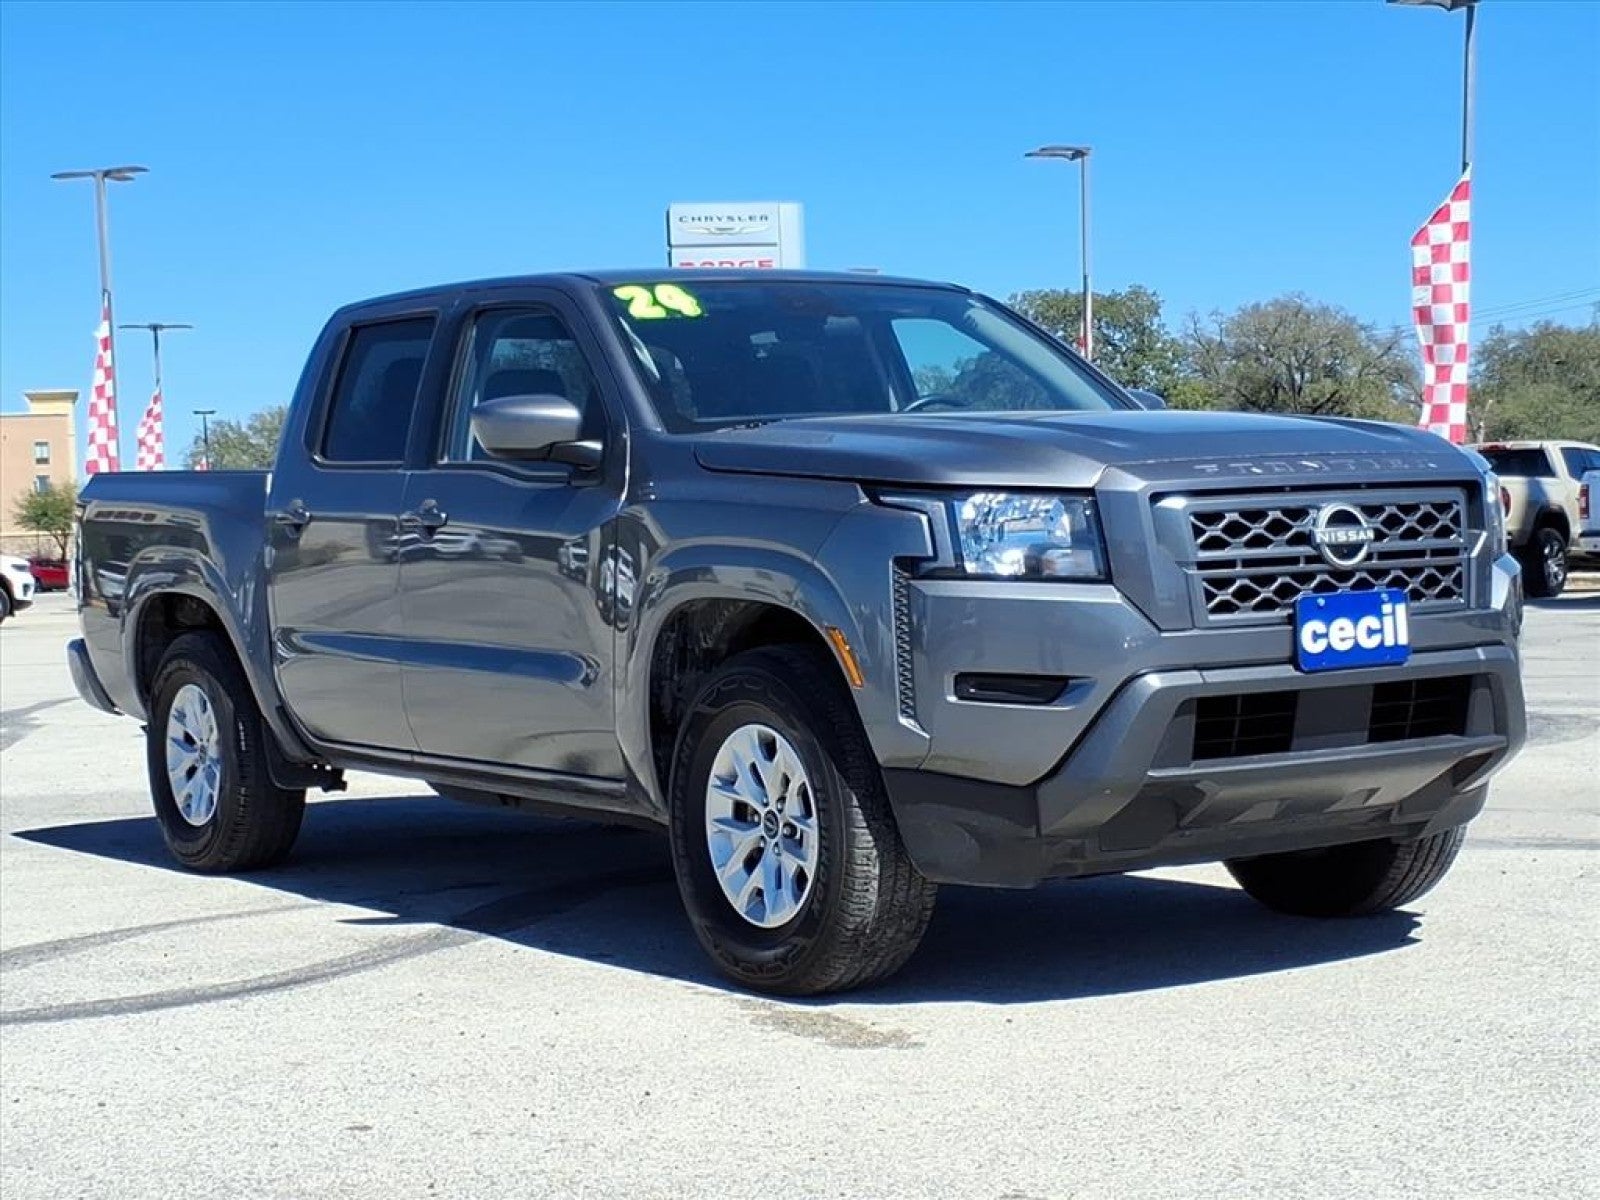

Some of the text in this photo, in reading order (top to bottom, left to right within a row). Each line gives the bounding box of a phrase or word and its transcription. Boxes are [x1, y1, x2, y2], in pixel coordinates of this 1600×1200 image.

[678, 213, 769, 223] CHRYSLER
[1315, 528, 1375, 543] NISSAN
[1301, 603, 1409, 654] cecil
